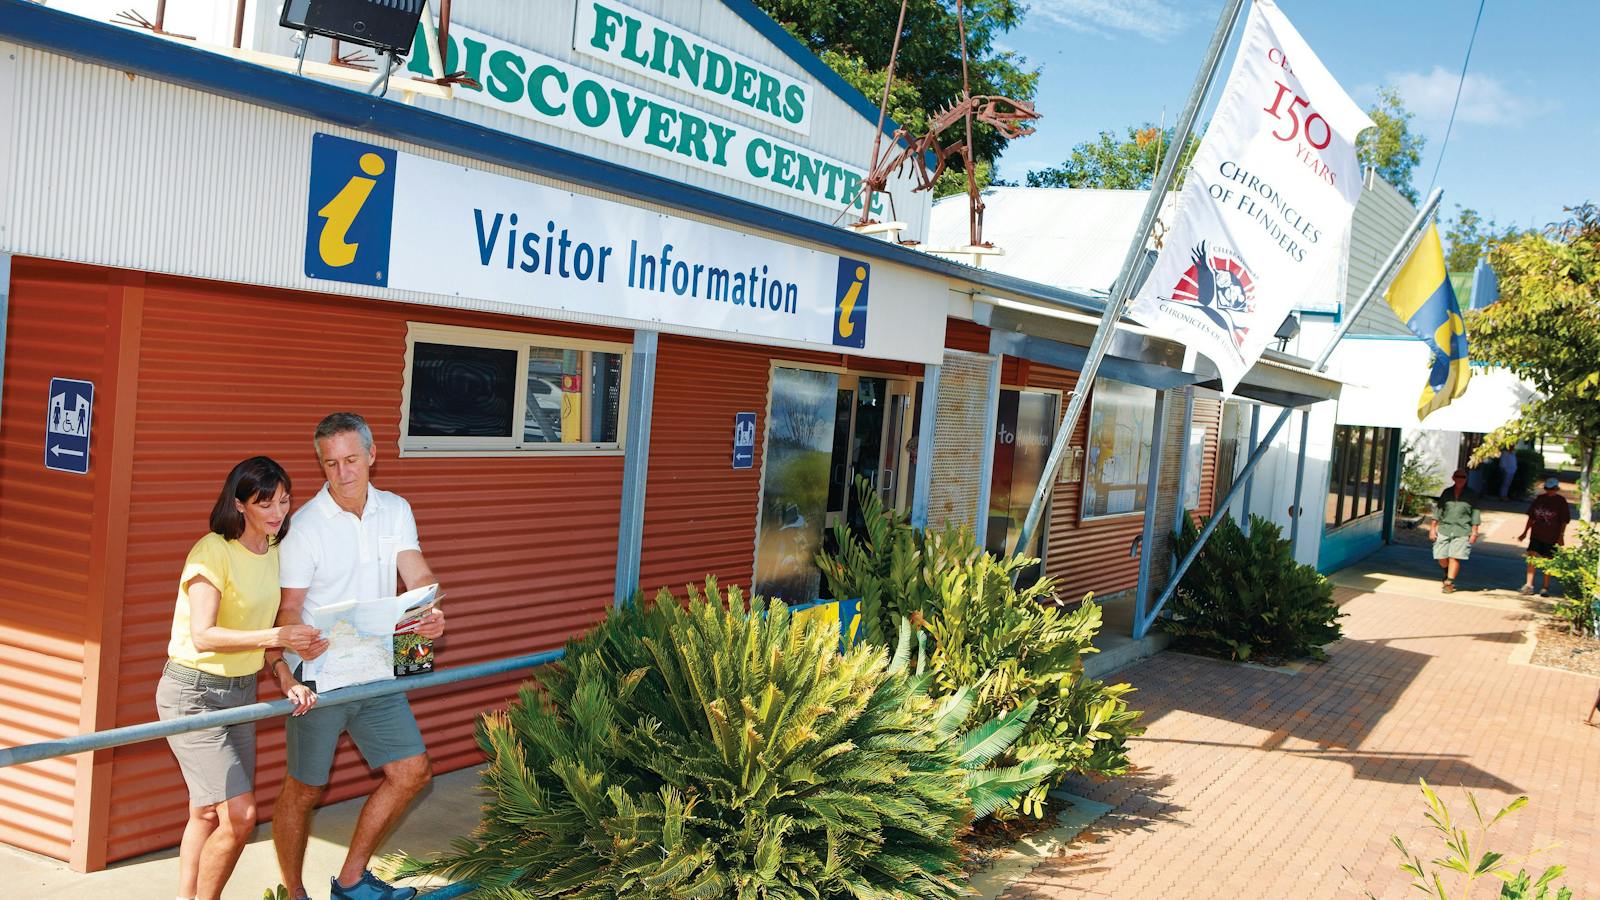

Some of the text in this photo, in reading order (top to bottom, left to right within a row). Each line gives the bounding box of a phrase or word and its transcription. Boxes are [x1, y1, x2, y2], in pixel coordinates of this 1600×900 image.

[406, 22, 737, 167] DISCOVERY
[591, 3, 806, 124] FLINDERS
[1263, 81, 1332, 150] 150
[1220, 161, 1322, 244] CHRONICLES
[1295, 143, 1337, 186] YEARS
[473, 208, 798, 314] Visitor Information
[1208, 184, 1234, 203] OF
[1237, 195, 1308, 263] FLINDERS
